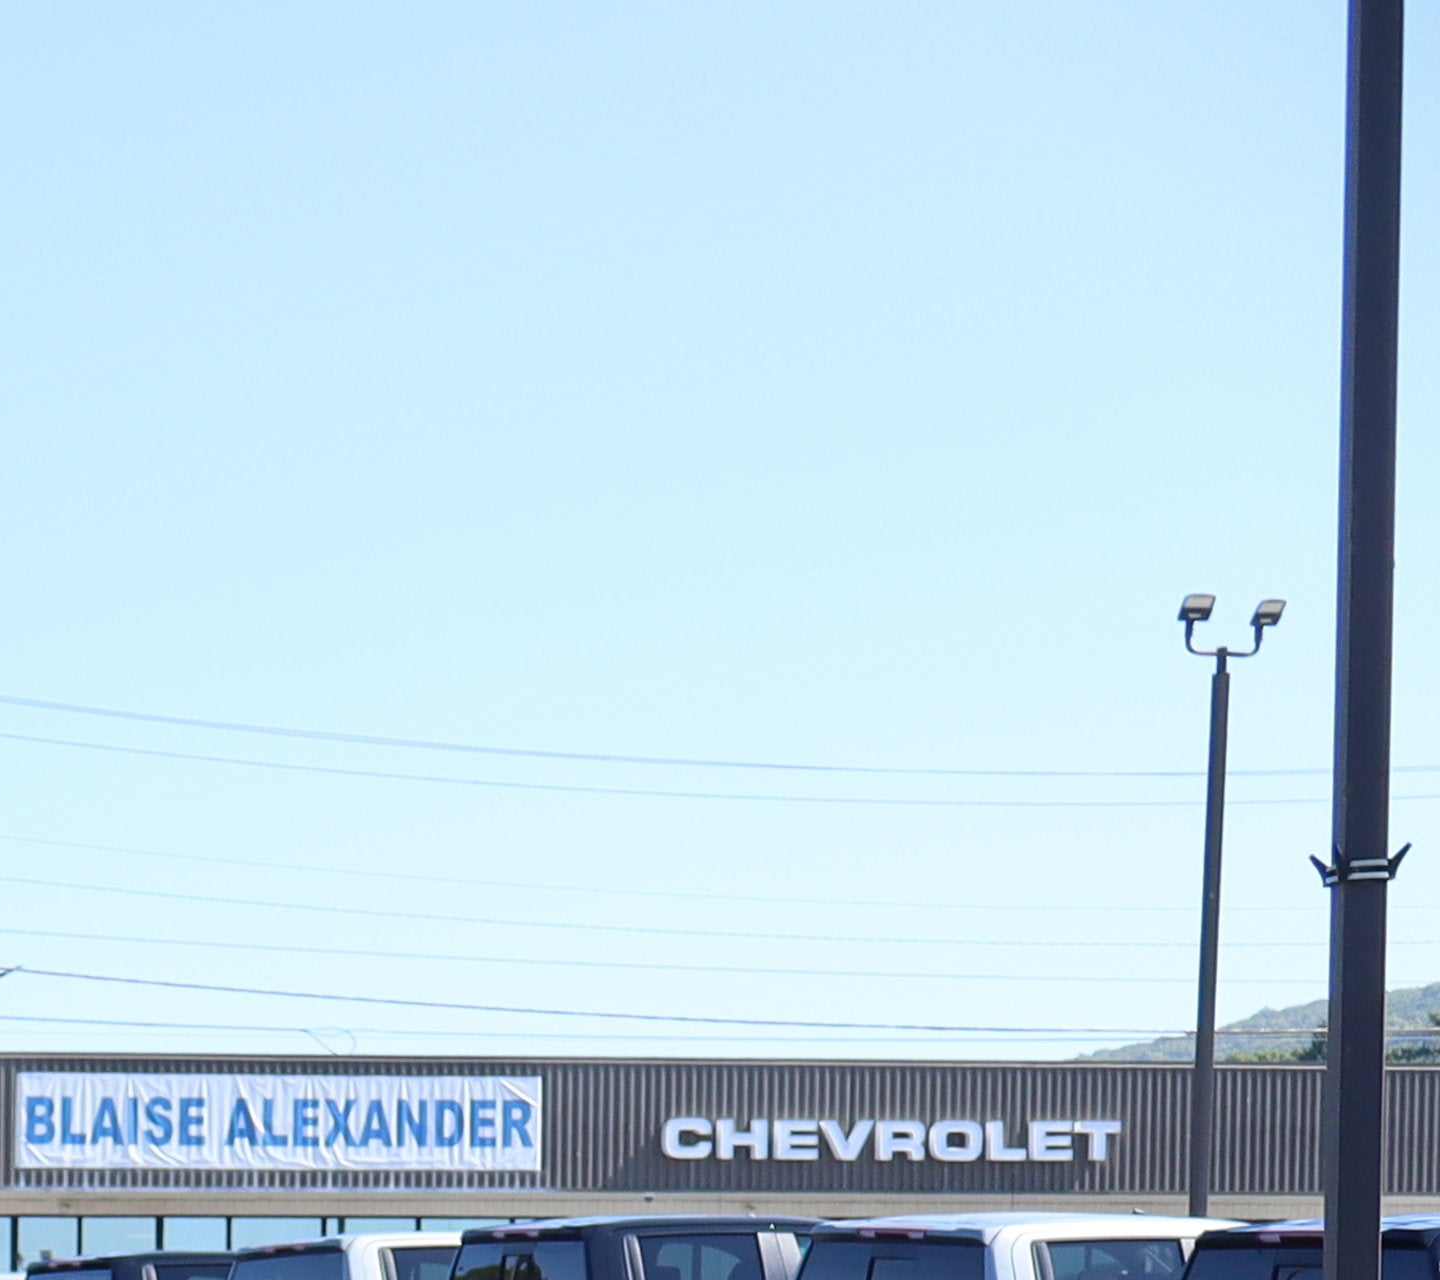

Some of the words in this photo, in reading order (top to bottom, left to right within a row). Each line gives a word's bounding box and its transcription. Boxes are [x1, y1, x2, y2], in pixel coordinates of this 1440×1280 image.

[24, 1094, 206, 1146] BLAISE
[225, 1096, 534, 1148] ALEXANDER
[661, 1116, 1123, 1162] CHEVROLET
